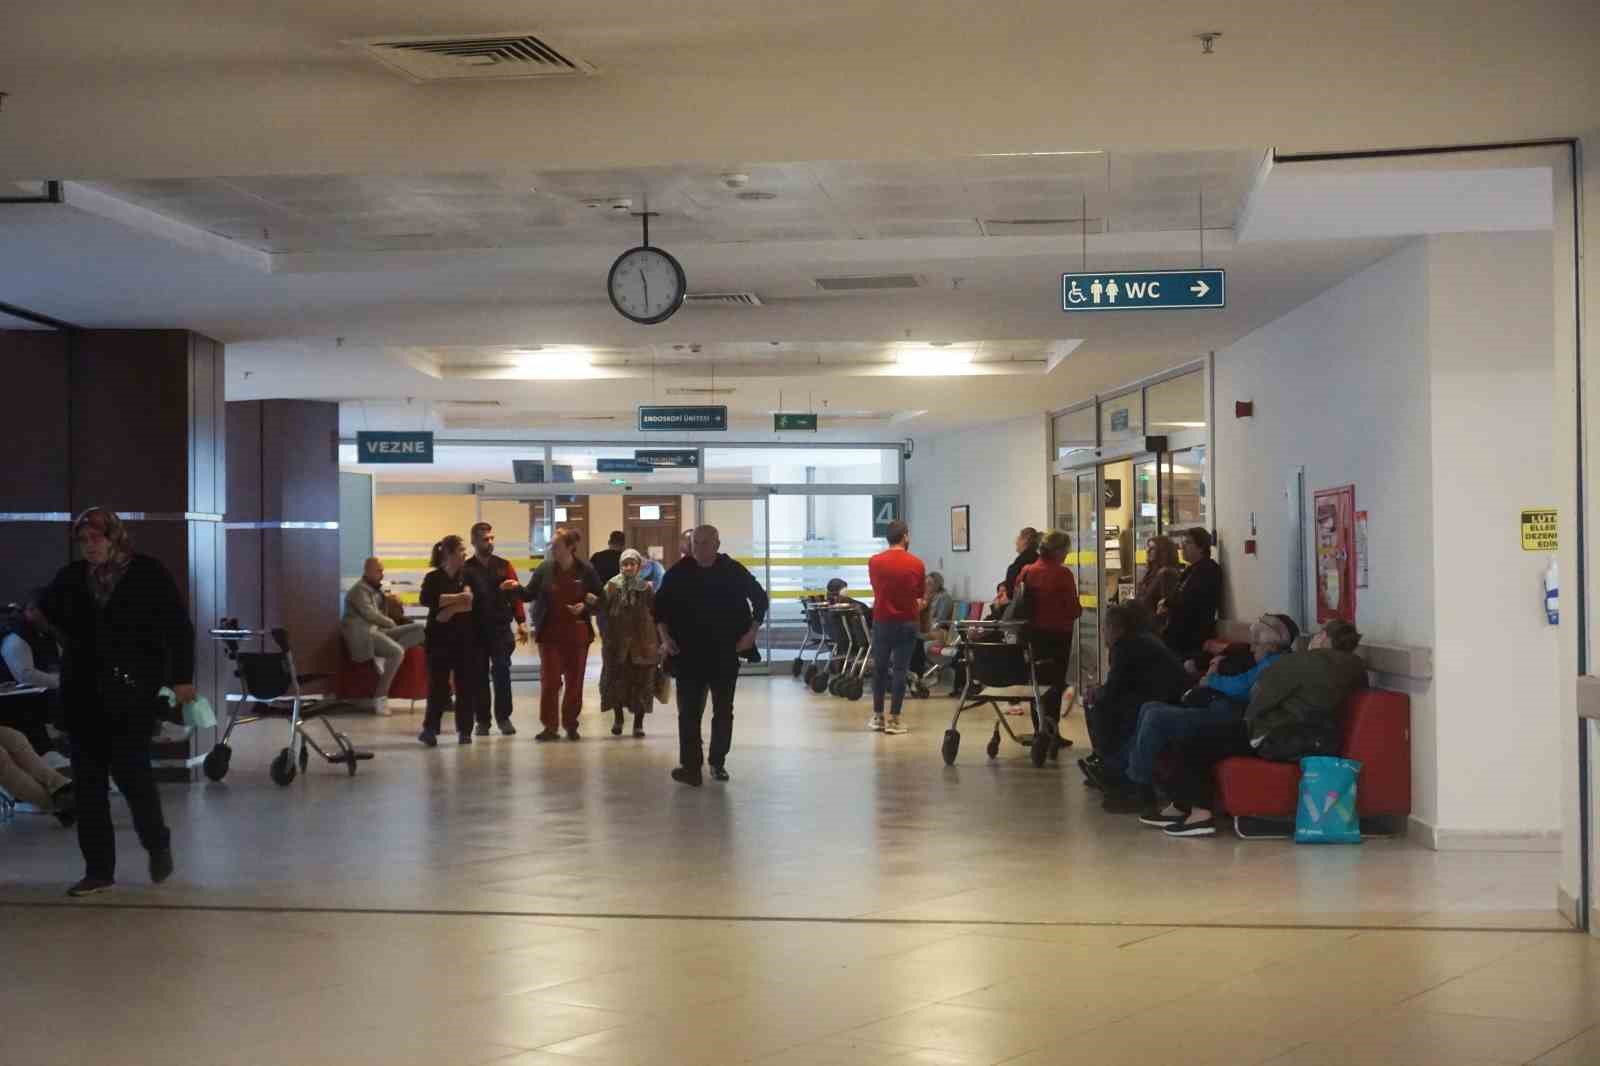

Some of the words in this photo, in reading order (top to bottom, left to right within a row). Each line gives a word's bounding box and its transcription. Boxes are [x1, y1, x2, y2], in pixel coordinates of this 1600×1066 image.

[1124, 281, 1161, 299] WC
[366, 440, 425, 453] VEZNE
[875, 501, 893, 524] 4
